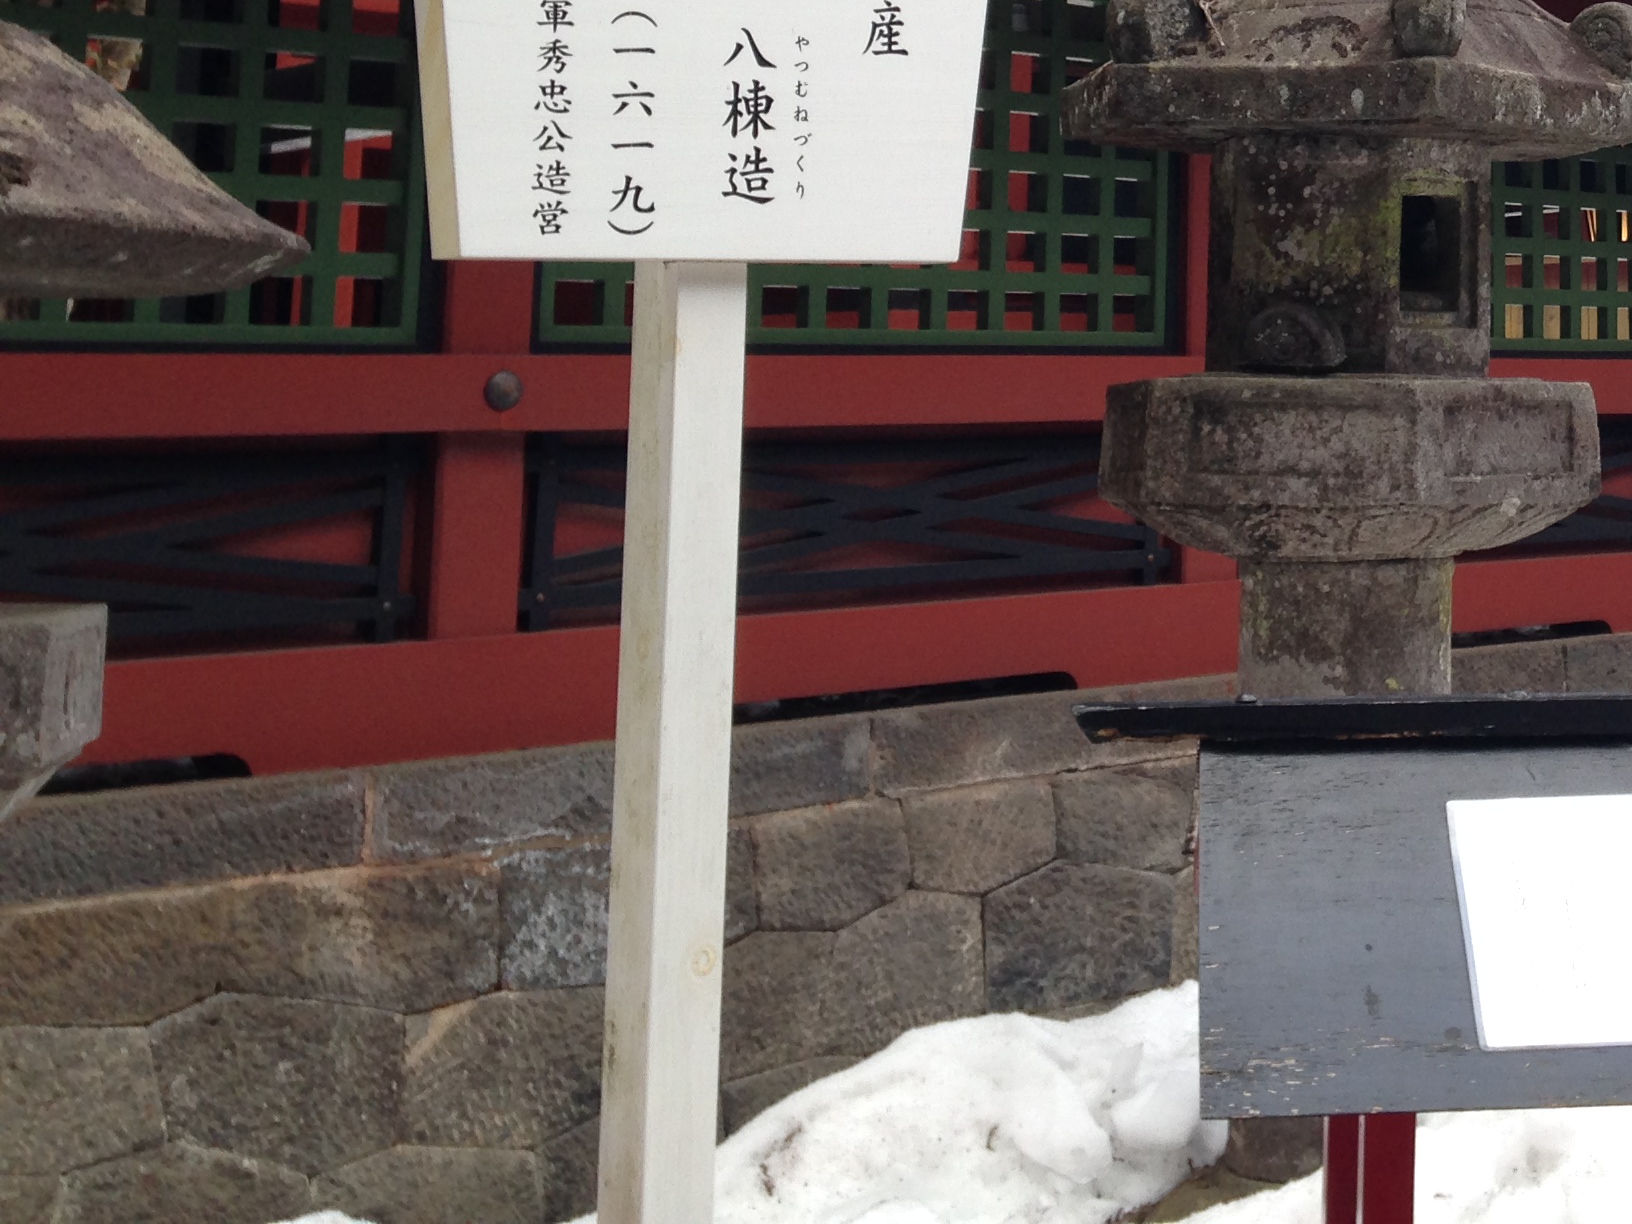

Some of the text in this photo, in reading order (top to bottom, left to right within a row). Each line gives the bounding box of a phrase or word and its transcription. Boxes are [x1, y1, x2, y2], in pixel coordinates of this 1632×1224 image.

[720, 26, 778, 205] 八棟造
[793, 34, 813, 200] やつむねづくり
